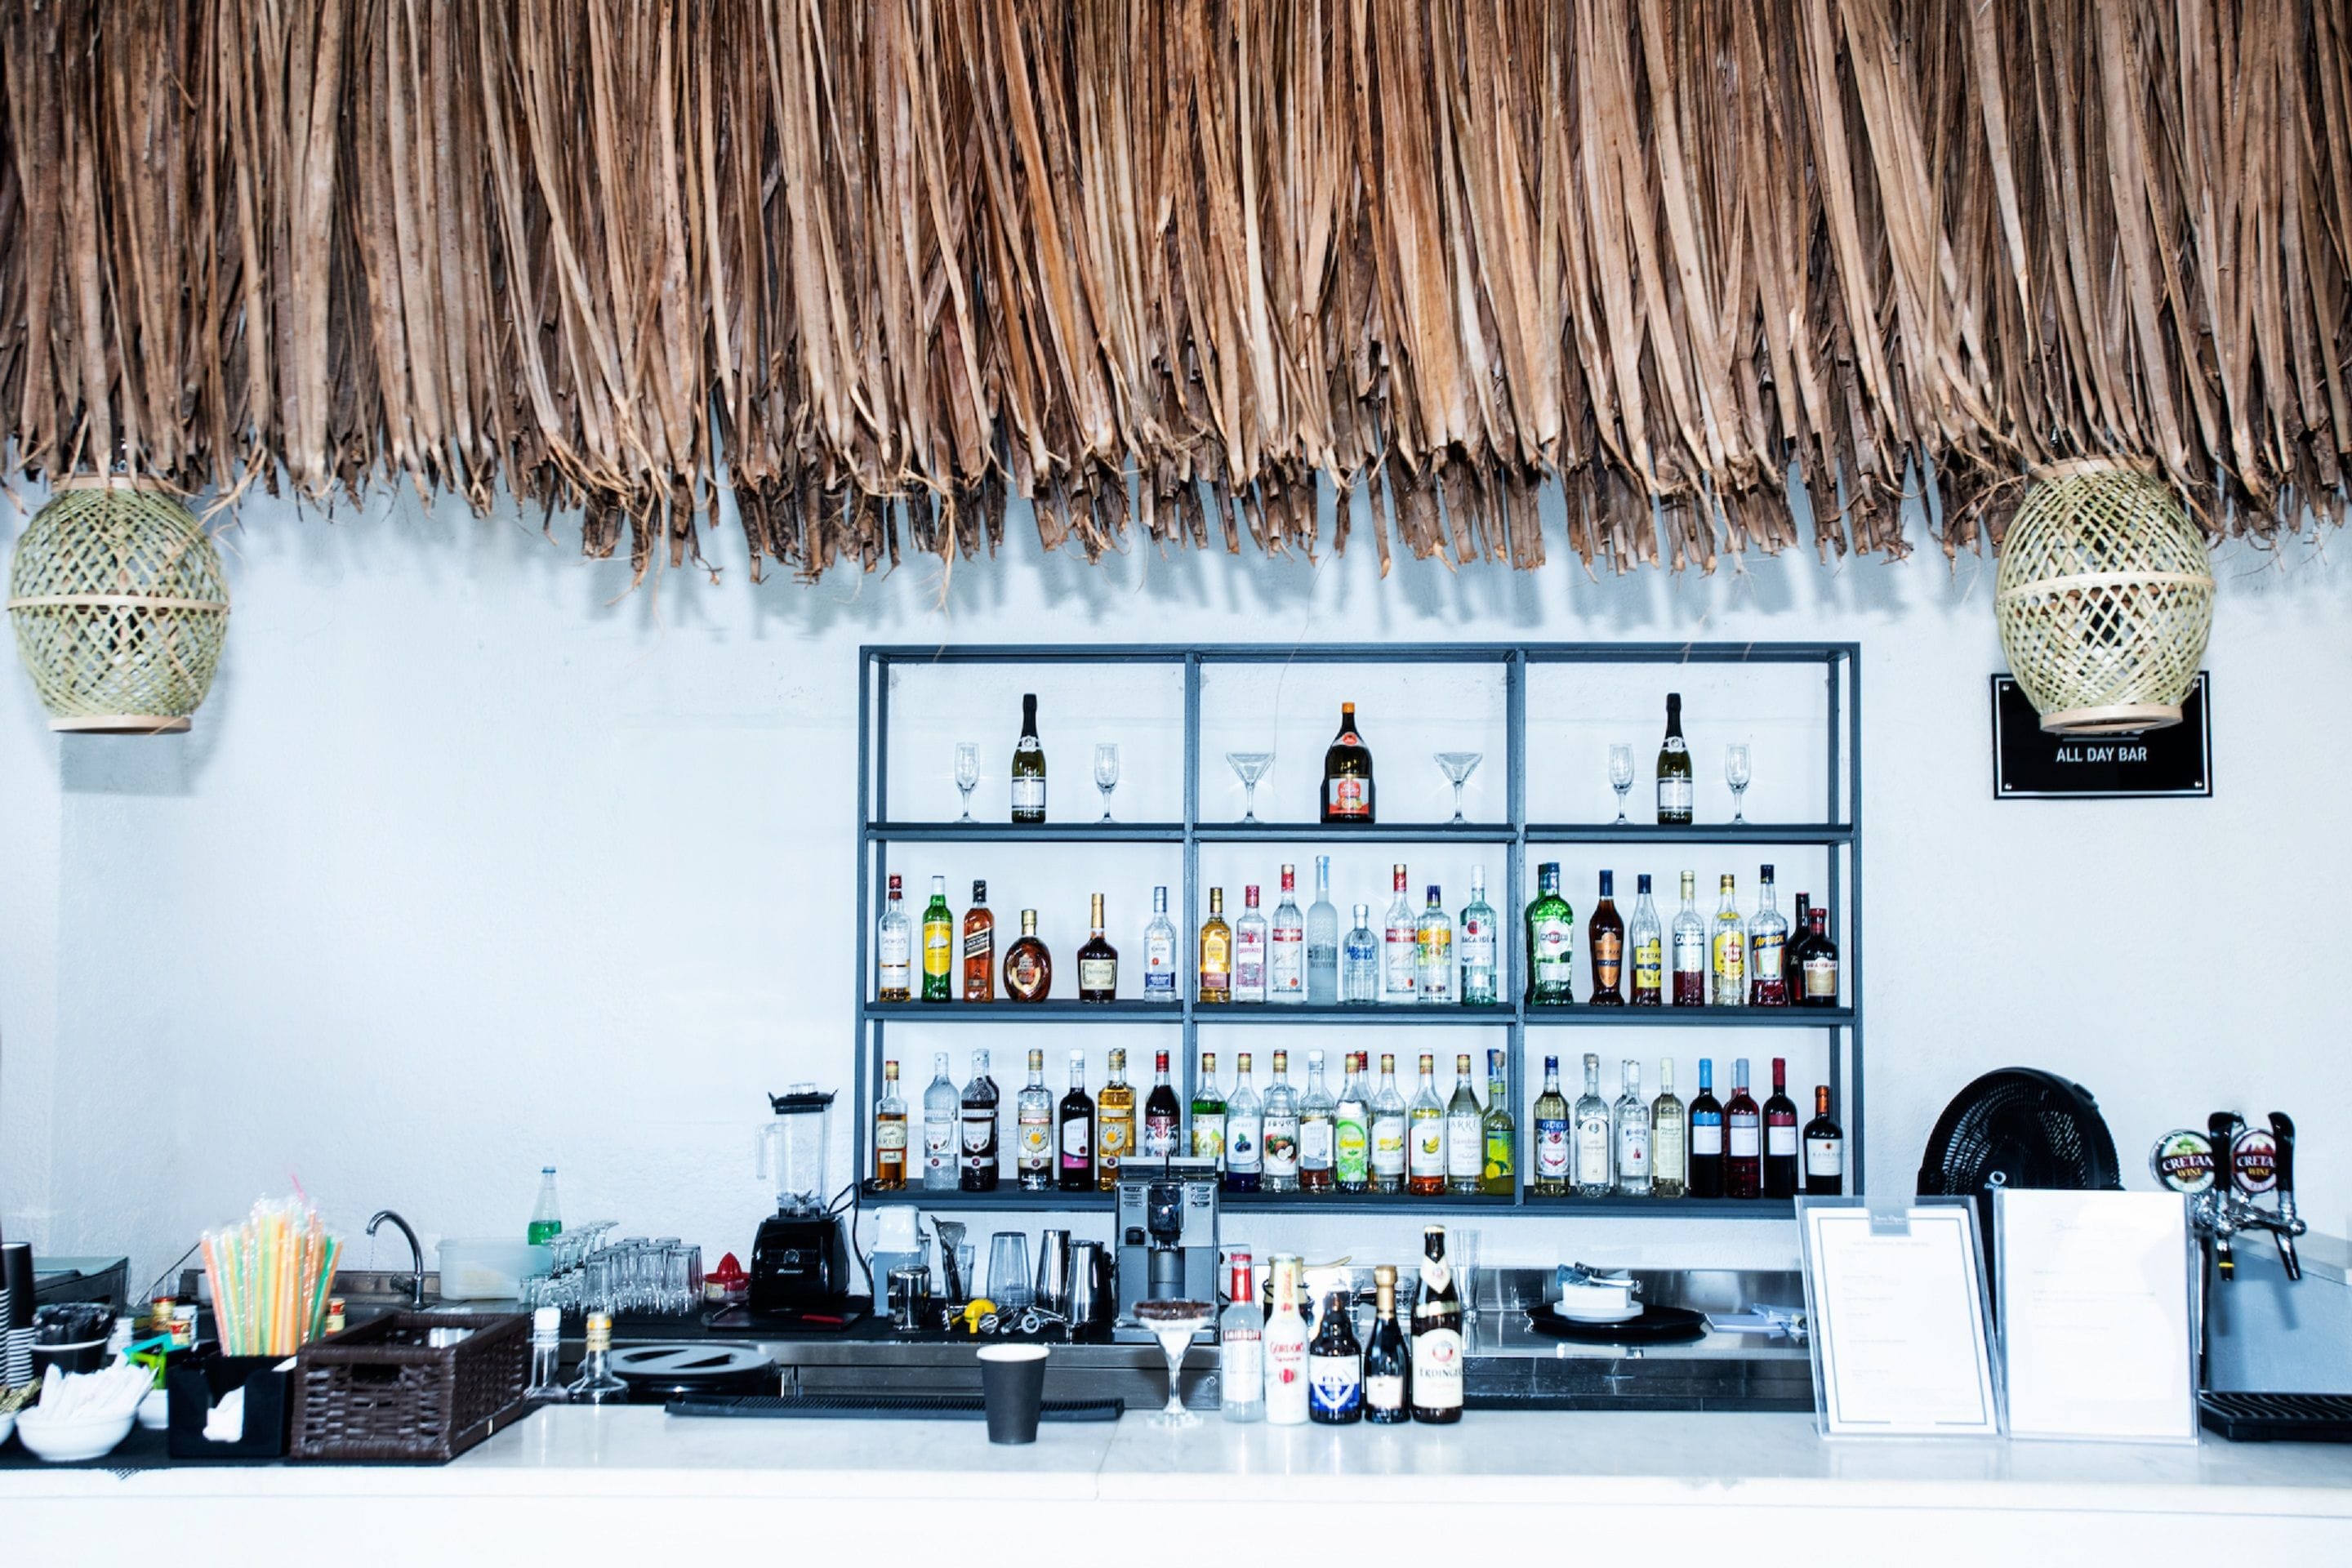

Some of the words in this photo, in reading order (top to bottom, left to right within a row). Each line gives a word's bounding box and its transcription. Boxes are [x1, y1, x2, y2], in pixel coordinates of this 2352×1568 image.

[2056, 747, 2082, 762] ALL
[2087, 747, 2114, 762] DAY
[2118, 746, 2147, 761] BAR
[2236, 1155, 2275, 1168] CRETA
[2176, 1168, 2203, 1178] WINE
[2247, 1168, 2270, 1176] WINE
